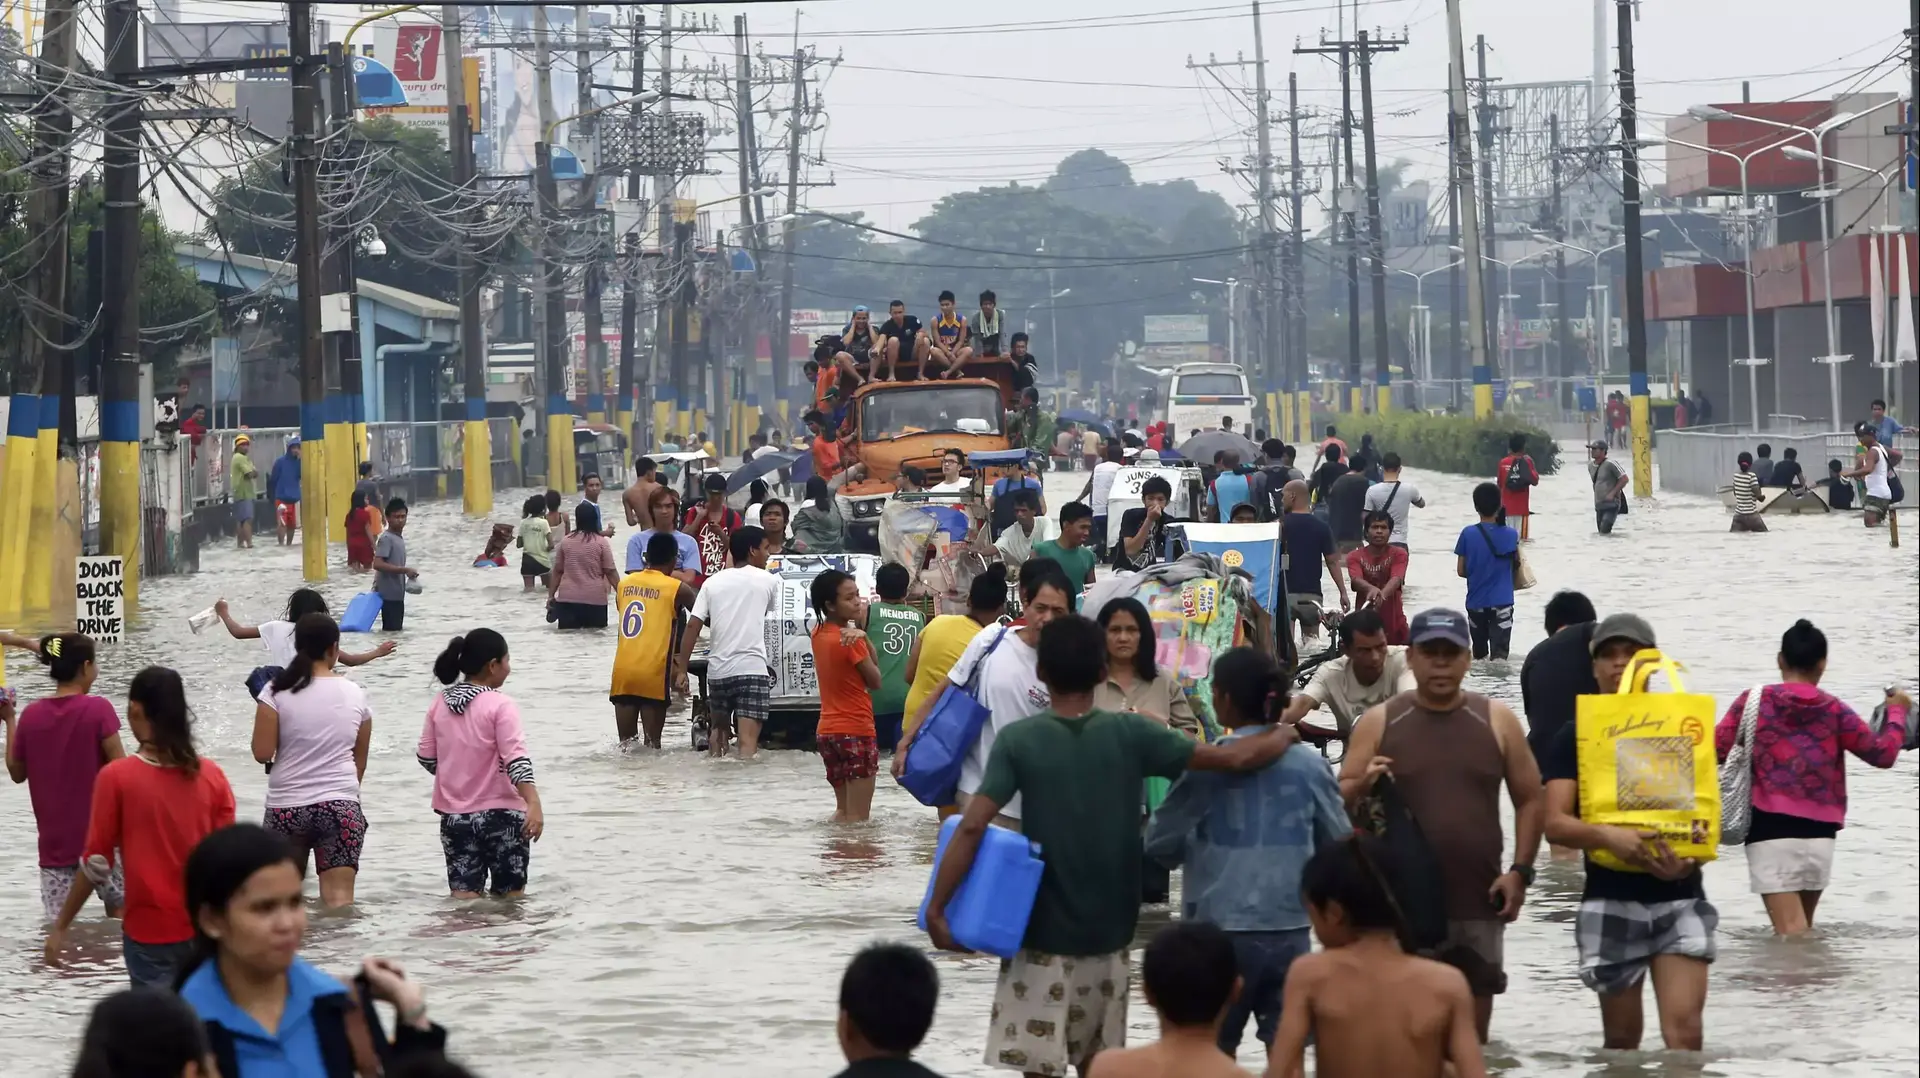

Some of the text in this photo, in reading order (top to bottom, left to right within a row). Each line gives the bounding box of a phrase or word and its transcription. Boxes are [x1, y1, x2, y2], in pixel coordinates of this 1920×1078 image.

[401, 84, 426, 92] cury
[1125, 471, 1158, 484] JUNSA
[1130, 481, 1142, 494] 3
[79, 560, 121, 578] DONT
[76, 579, 123, 599] BLOCK
[622, 585, 660, 600] FERNANDO
[86, 599, 114, 616] THE
[879, 607, 920, 622] MENDERO
[77, 616, 121, 634] DRIVE
[622, 600, 645, 639] 6
[882, 622, 918, 657] 31
